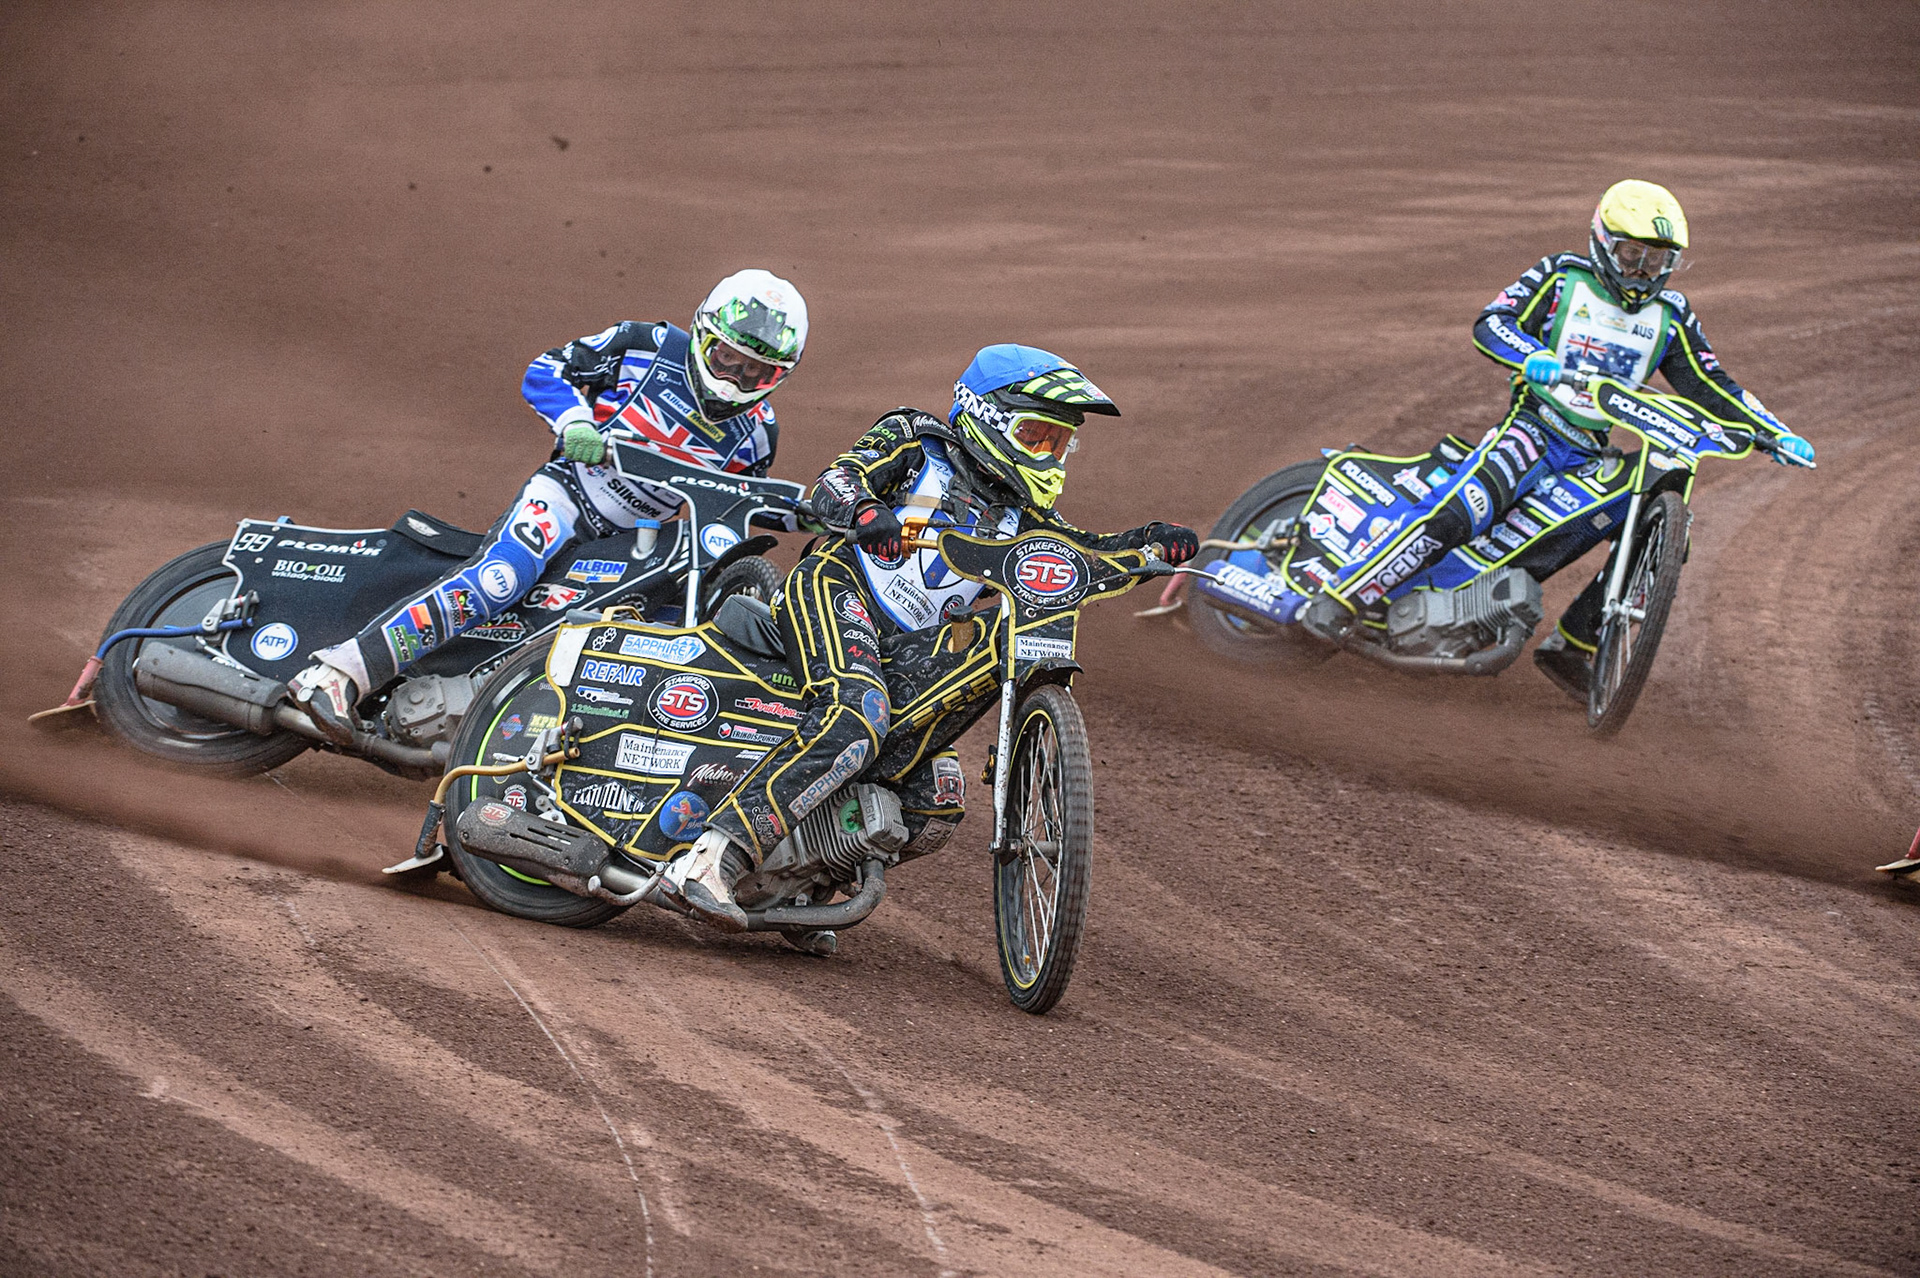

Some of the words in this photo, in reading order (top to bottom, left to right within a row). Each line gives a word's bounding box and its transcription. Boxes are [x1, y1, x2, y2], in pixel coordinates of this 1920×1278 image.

[1631, 324, 1655, 340] AUS
[663, 391, 692, 415] Allied
[690, 412, 723, 440] Mobility
[1608, 393, 1697, 448] POLCOPPER
[606, 478, 661, 518] Silkolene
[234, 532, 274, 552] 99
[1016, 541, 1077, 560] STAKEFORD
[571, 560, 627, 575] ALBON
[1018, 560, 1073, 585] STS
[490, 568, 509, 594] ATPI
[896, 579, 933, 616] Maintenance
[1013, 584, 1034, 602] TYRE
[889, 589, 926, 621] NETWORK
[259, 635, 289, 649] ATPI
[393, 627, 406, 647] ROCK
[624, 636, 687, 657] SAPPHIRE
[1020, 639, 1069, 651] Maintenance
[1021, 649, 1068, 659] NETWORK
[581, 661, 645, 685] REFAIR
[664, 676, 710, 691] STAKEFORD
[659, 690, 705, 711] STS
[652, 707, 670, 724] TYRE
[669, 715, 708, 729] SERVICES
[623, 738, 687, 757] Maintenance
[622, 754, 681, 770] NETWORK
[792, 758, 854, 814] SAPPHIRE
[505, 795, 524, 810] STS
[482, 807, 508, 819] STS
